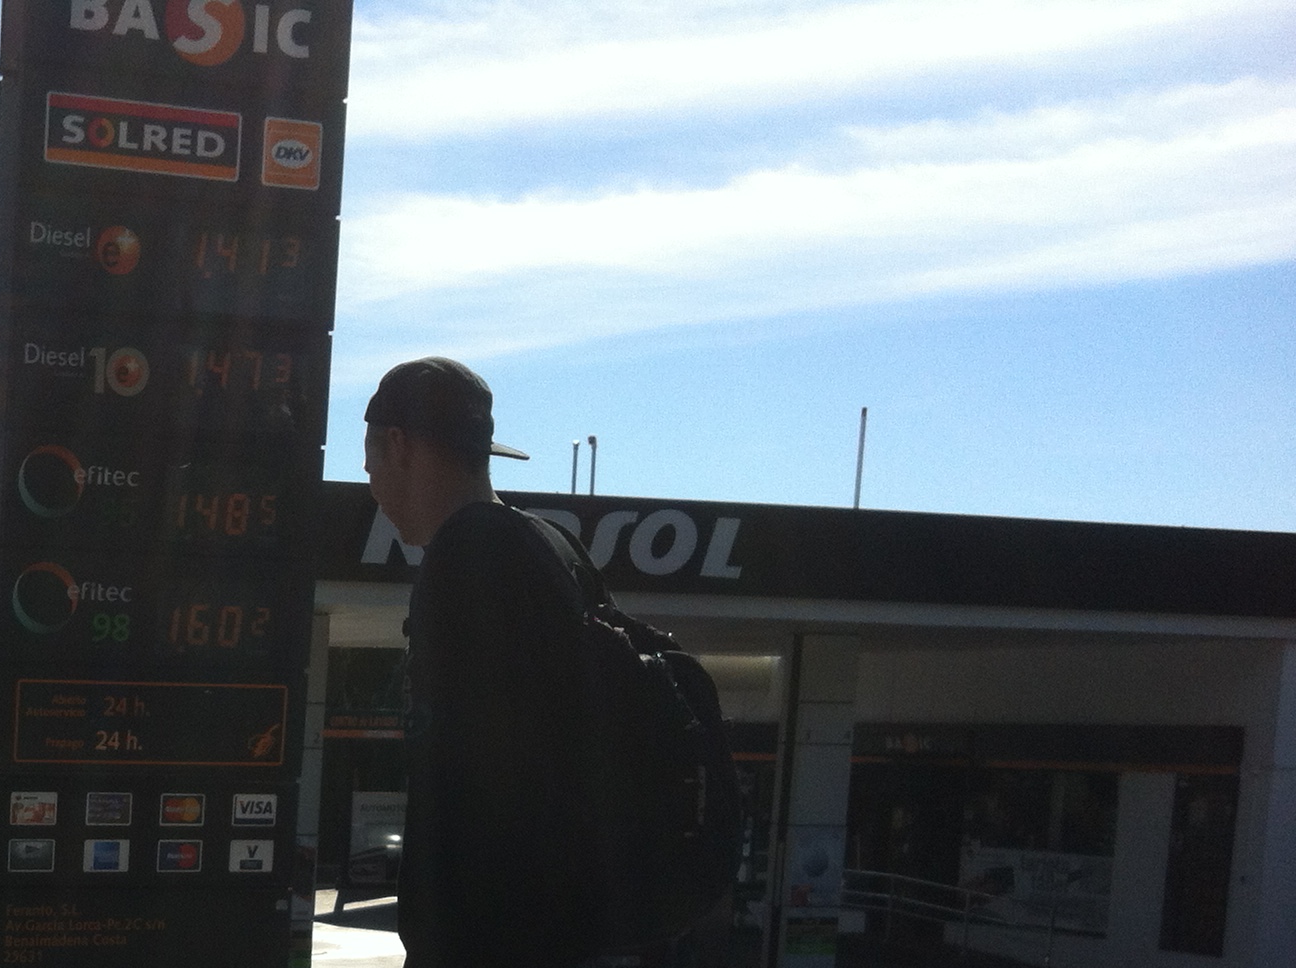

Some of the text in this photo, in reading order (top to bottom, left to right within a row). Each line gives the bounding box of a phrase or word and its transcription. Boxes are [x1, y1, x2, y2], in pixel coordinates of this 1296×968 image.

[70, 0, 312, 59] BASIC
[61, 114, 226, 159] SOLRED
[29, 220, 91, 249] Diesel
[24, 342, 85, 368] Diesel
[91, 613, 130, 642] 98
[103, 696, 127, 718] 24
[95, 729, 120, 751] 24
[125, 729, 143, 751] h.
[238, 800, 273, 815] VISA
[92, 933, 128, 947] Costa
